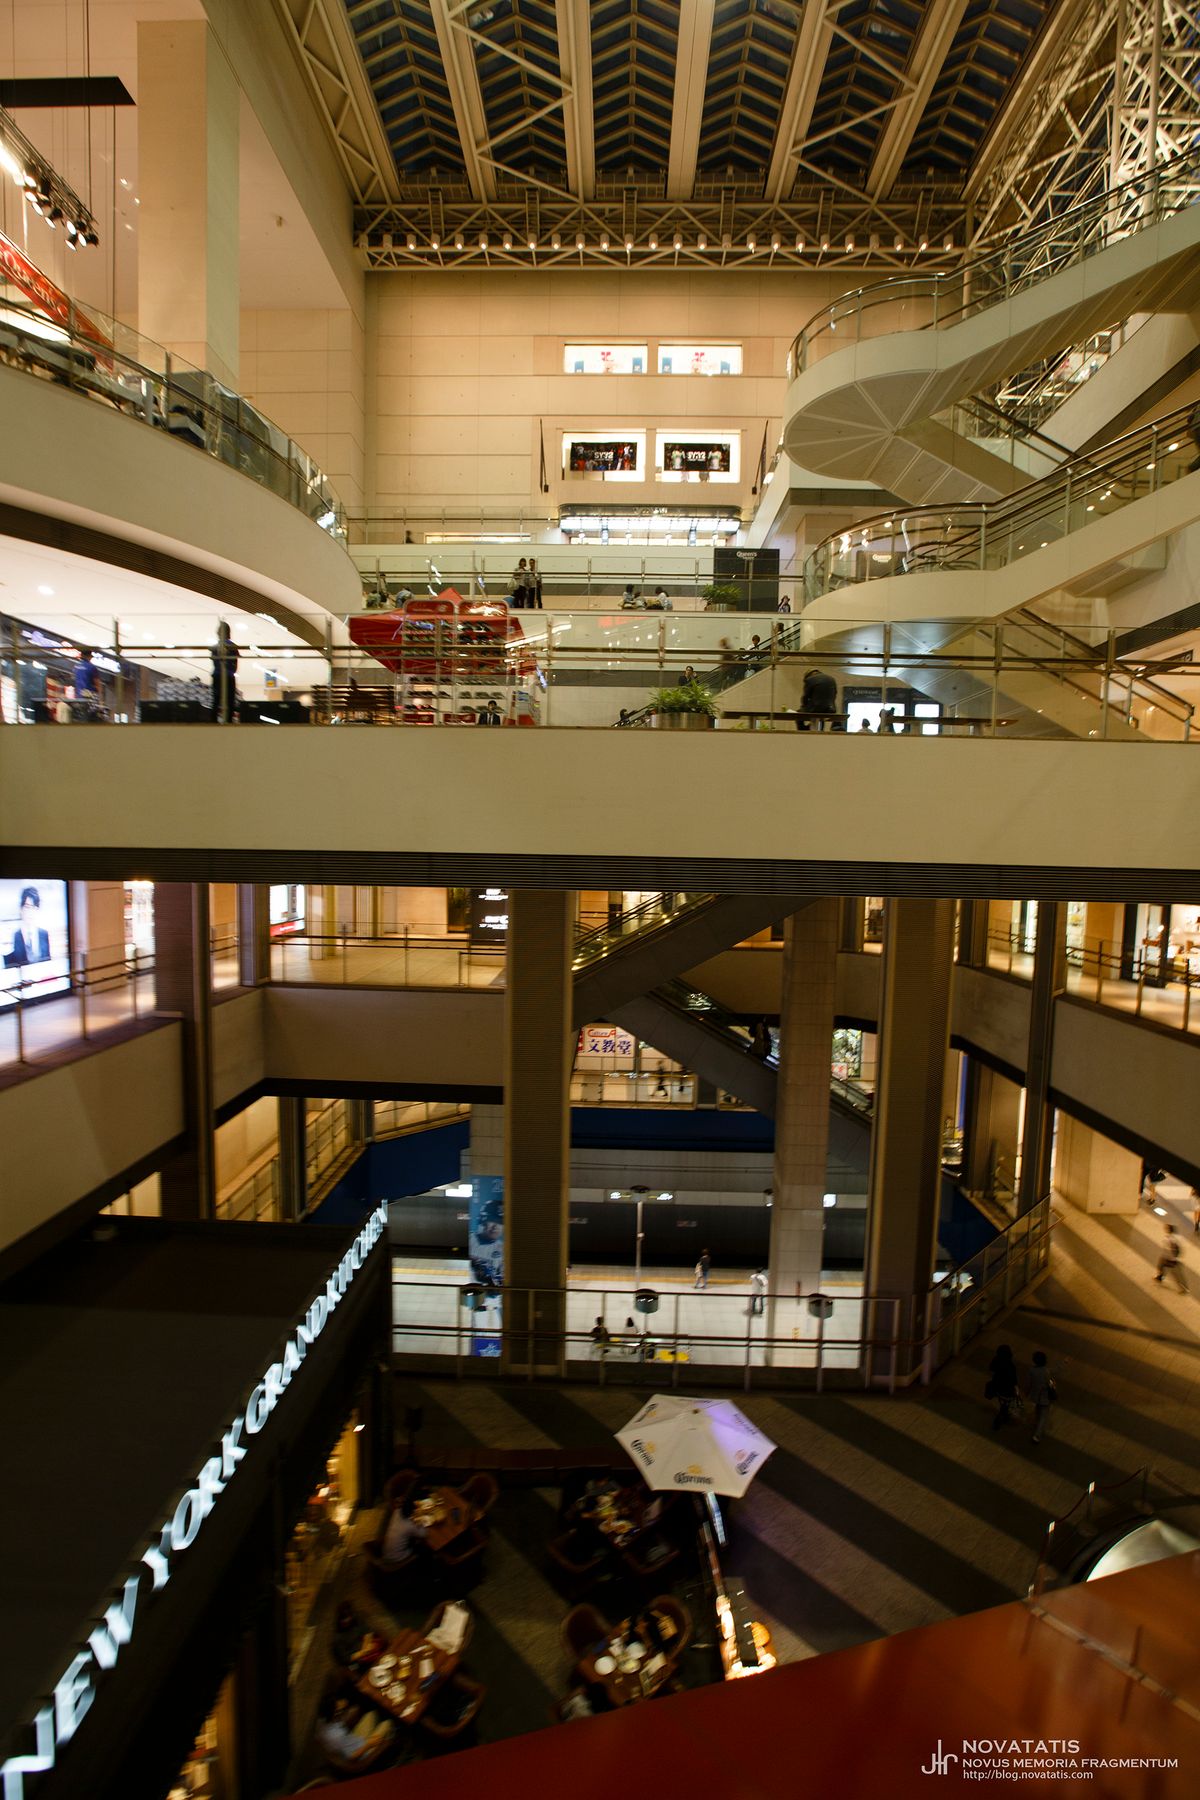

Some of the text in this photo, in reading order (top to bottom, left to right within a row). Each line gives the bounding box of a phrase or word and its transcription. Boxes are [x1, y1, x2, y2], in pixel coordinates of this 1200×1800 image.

[0, 1575, 141, 1800] NEW
[141, 1415, 247, 1592] YORK
[245, 1295, 328, 1434] GRAND
